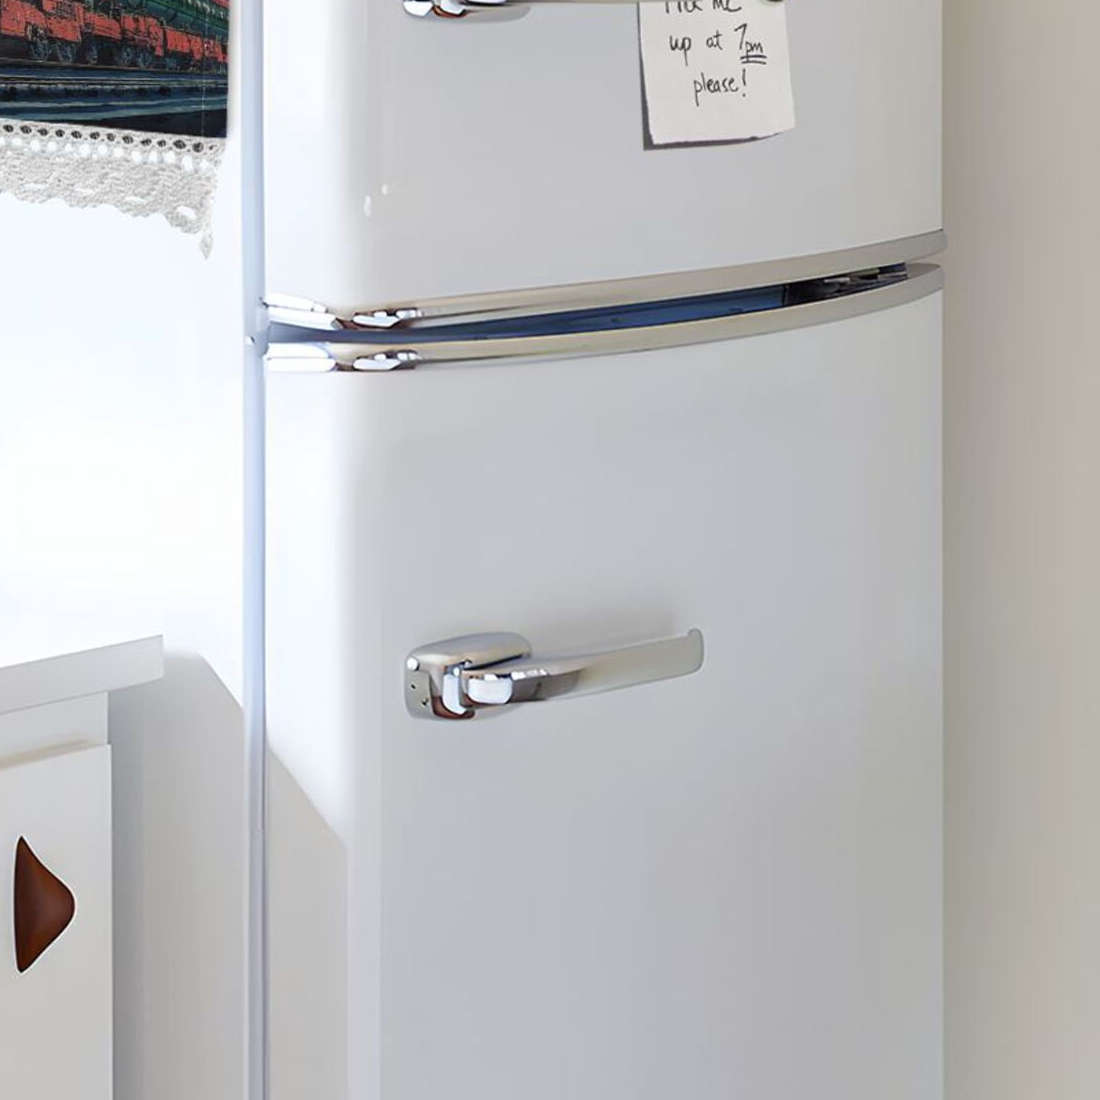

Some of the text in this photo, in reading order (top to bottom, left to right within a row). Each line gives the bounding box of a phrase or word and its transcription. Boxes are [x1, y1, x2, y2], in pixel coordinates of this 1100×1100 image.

[669, 35, 692, 67] up
[706, 30, 723, 51] at
[693, 68, 746, 107] please!
